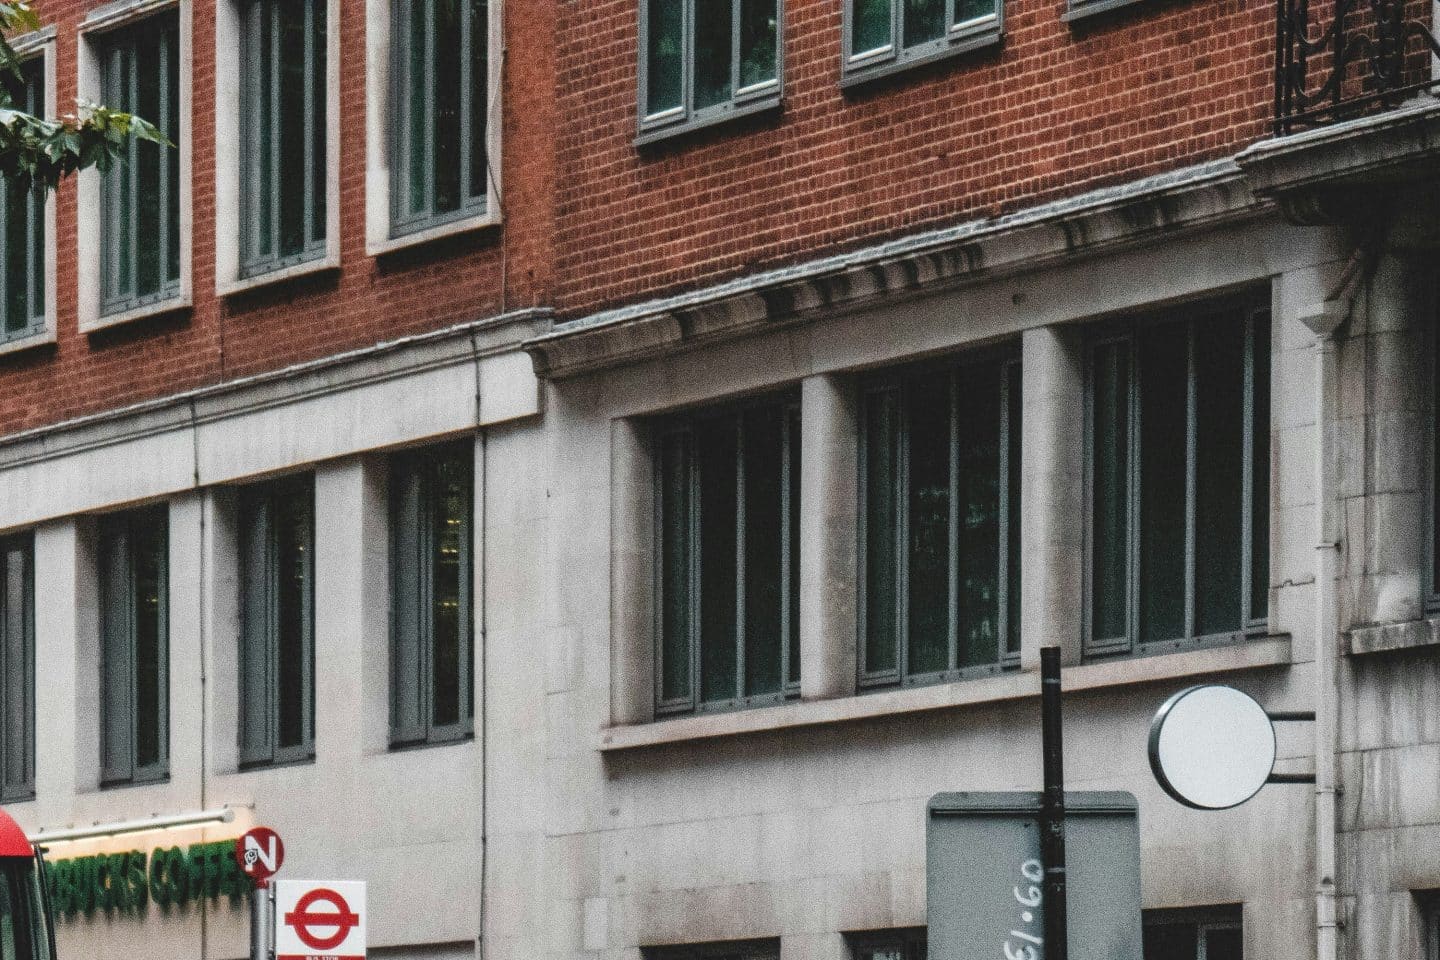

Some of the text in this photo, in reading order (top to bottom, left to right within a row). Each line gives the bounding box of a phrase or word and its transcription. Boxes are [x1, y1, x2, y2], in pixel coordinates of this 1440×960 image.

[44, 838, 252, 912] BUCKS COFFE
[245, 836, 276, 871] N
